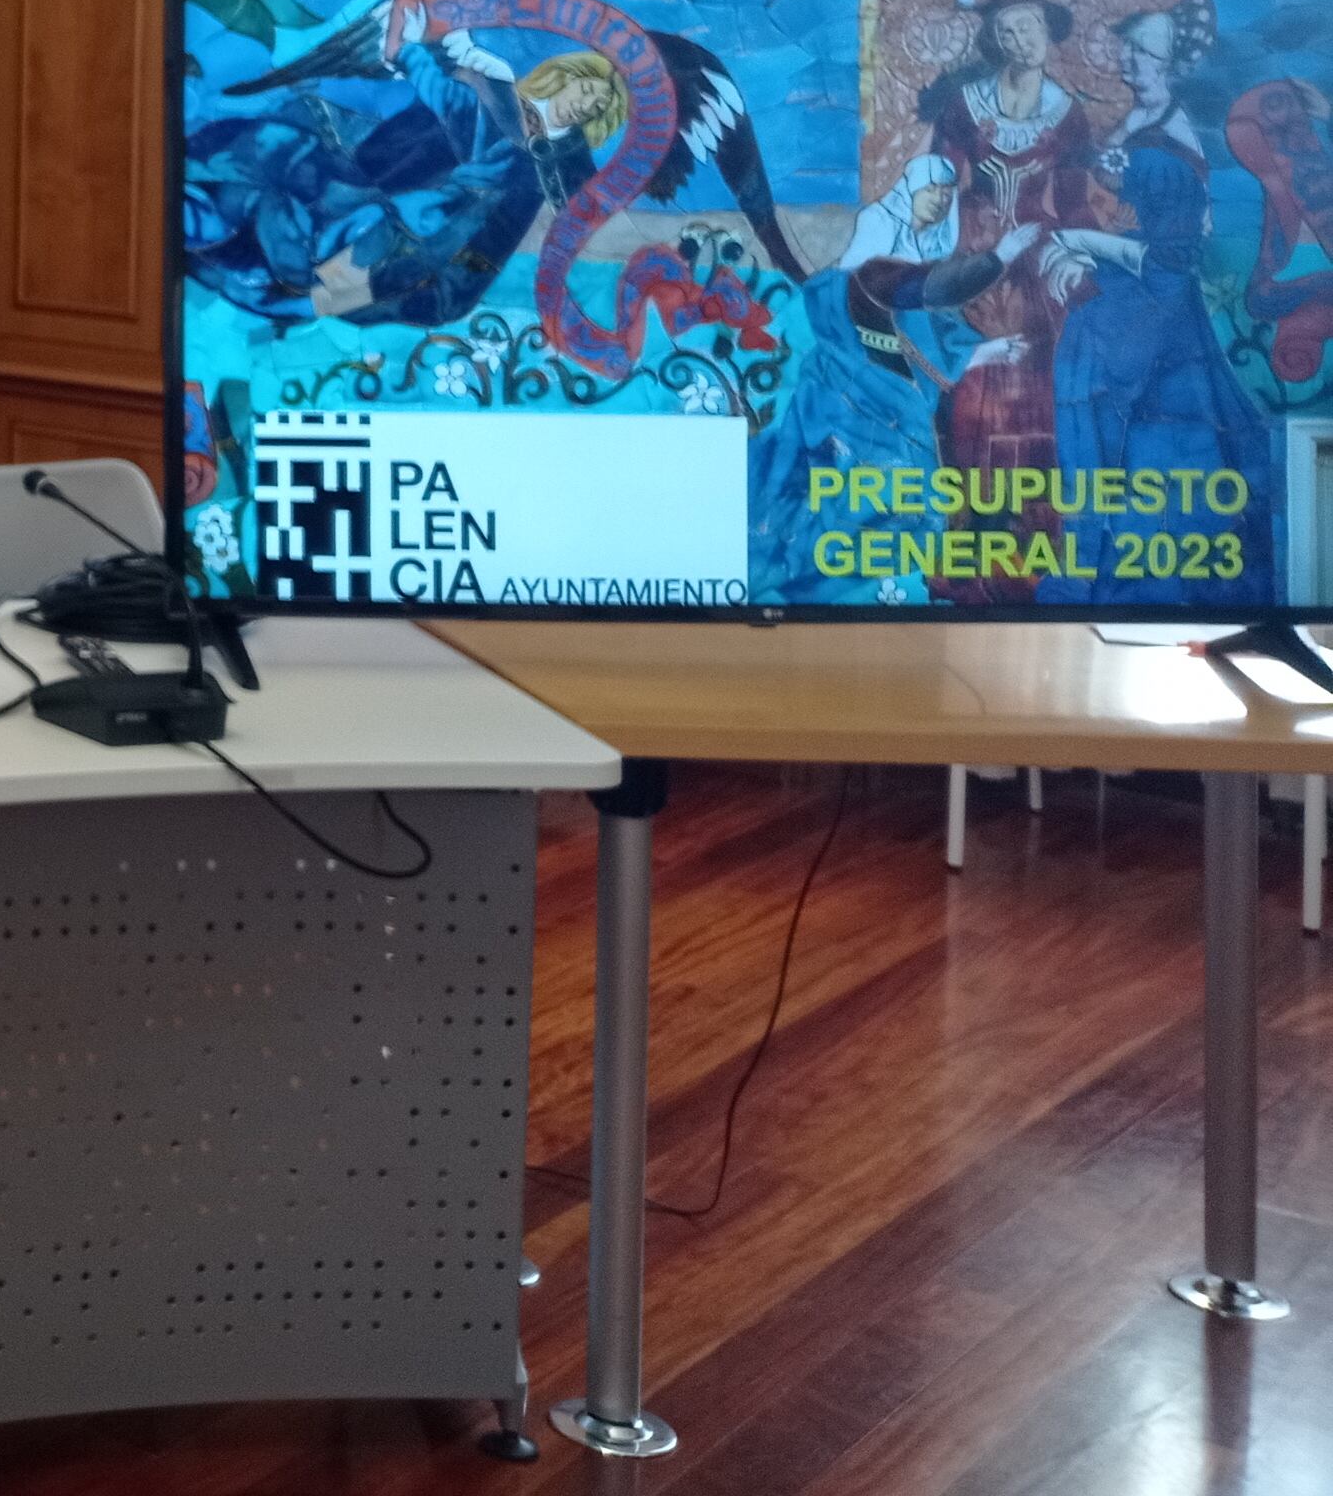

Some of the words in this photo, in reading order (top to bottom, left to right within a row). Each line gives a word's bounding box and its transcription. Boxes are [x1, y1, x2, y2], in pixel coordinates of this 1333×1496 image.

[390, 461, 459, 502] PA
[809, 466, 1250, 515] PRESUPUESTO
[391, 510, 497, 552] LEN
[813, 531, 1098, 579] GENERAL
[1113, 531, 1245, 579] 2023
[390, 559, 487, 604] CIA
[500, 576, 747, 605] AYUNTAMIENTO
